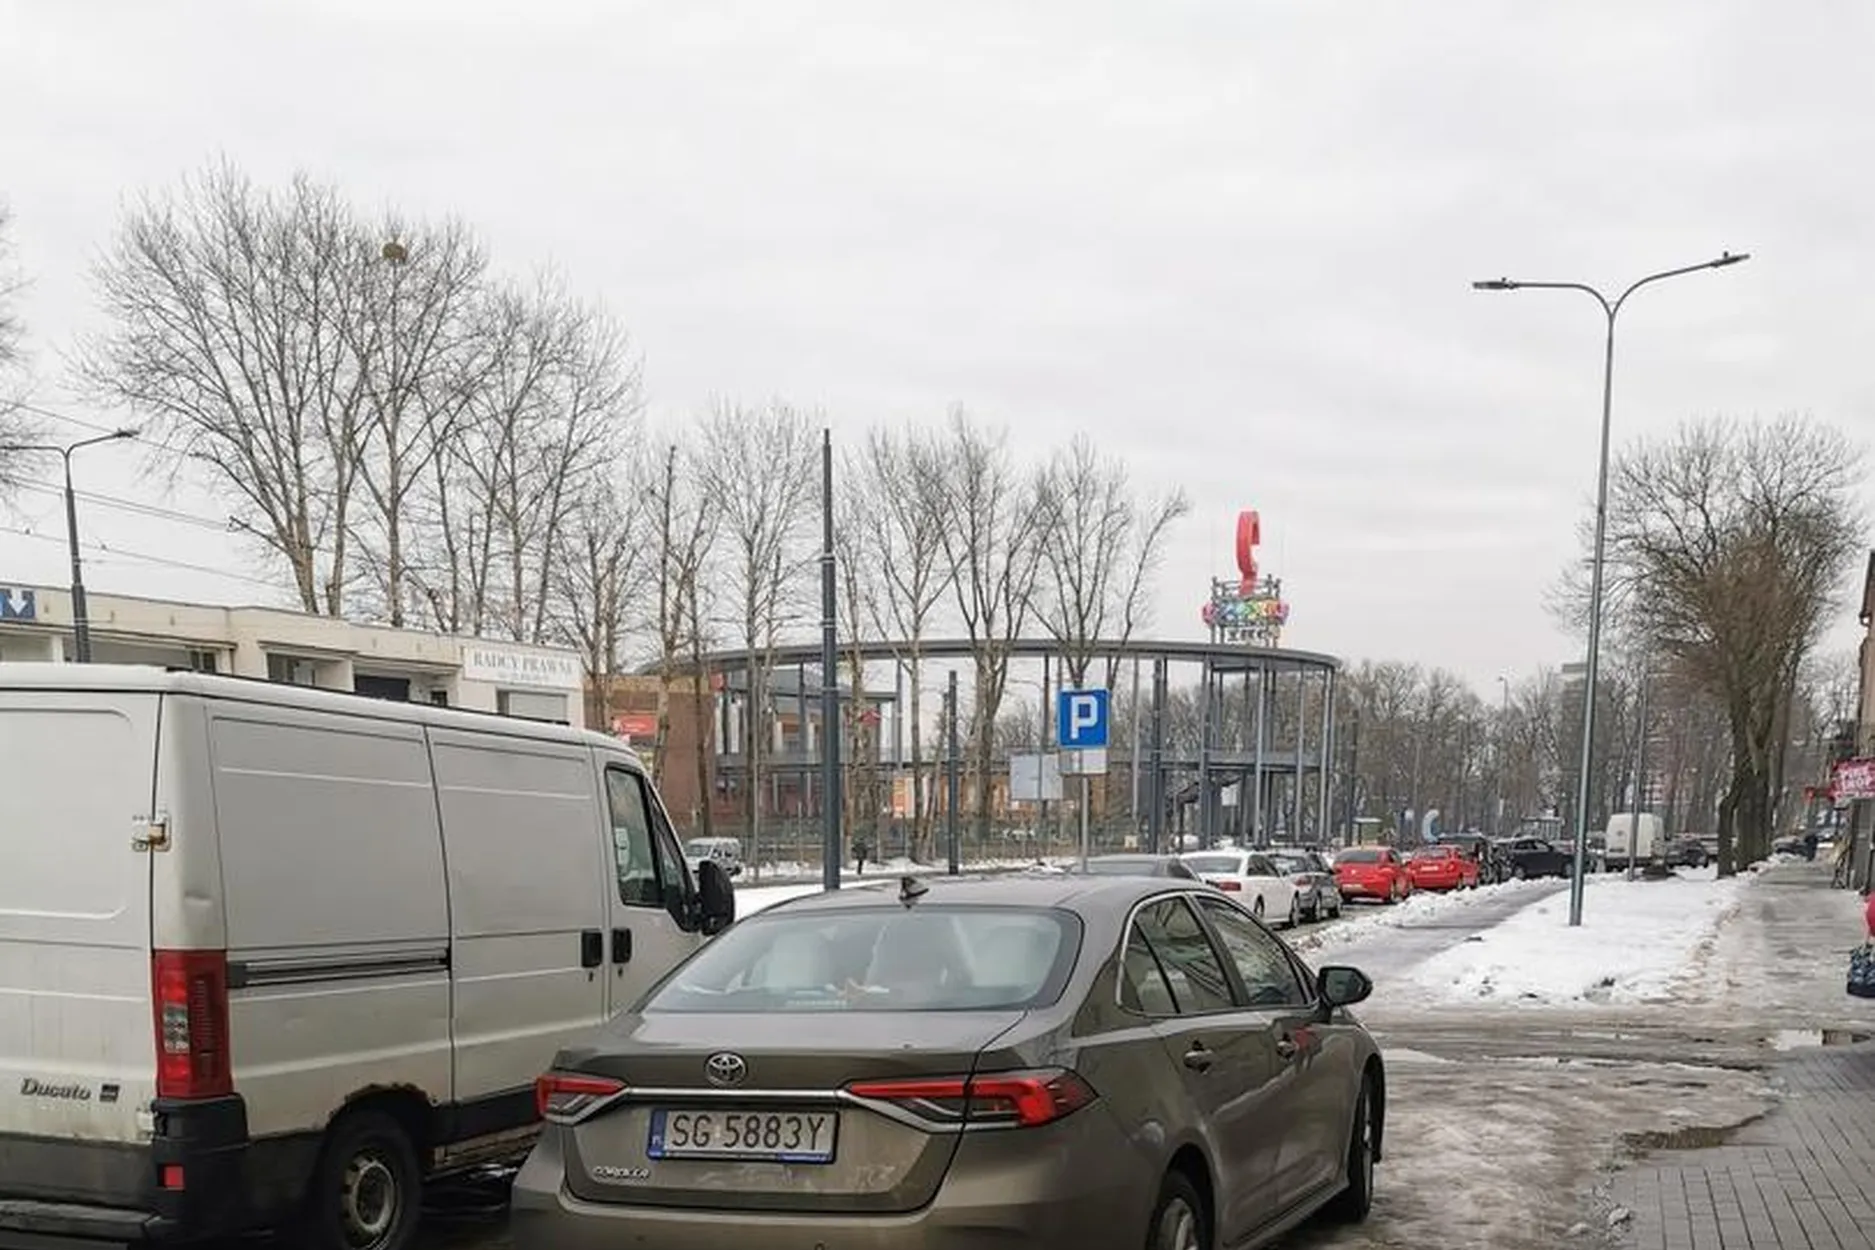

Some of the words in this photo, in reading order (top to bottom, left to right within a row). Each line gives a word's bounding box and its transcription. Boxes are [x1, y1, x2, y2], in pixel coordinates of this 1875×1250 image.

[1070, 694, 1099, 740] P
[21, 1077, 92, 1101] Ducato
[671, 1113, 712, 1148] SG
[723, 1115, 825, 1151] 5883Y
